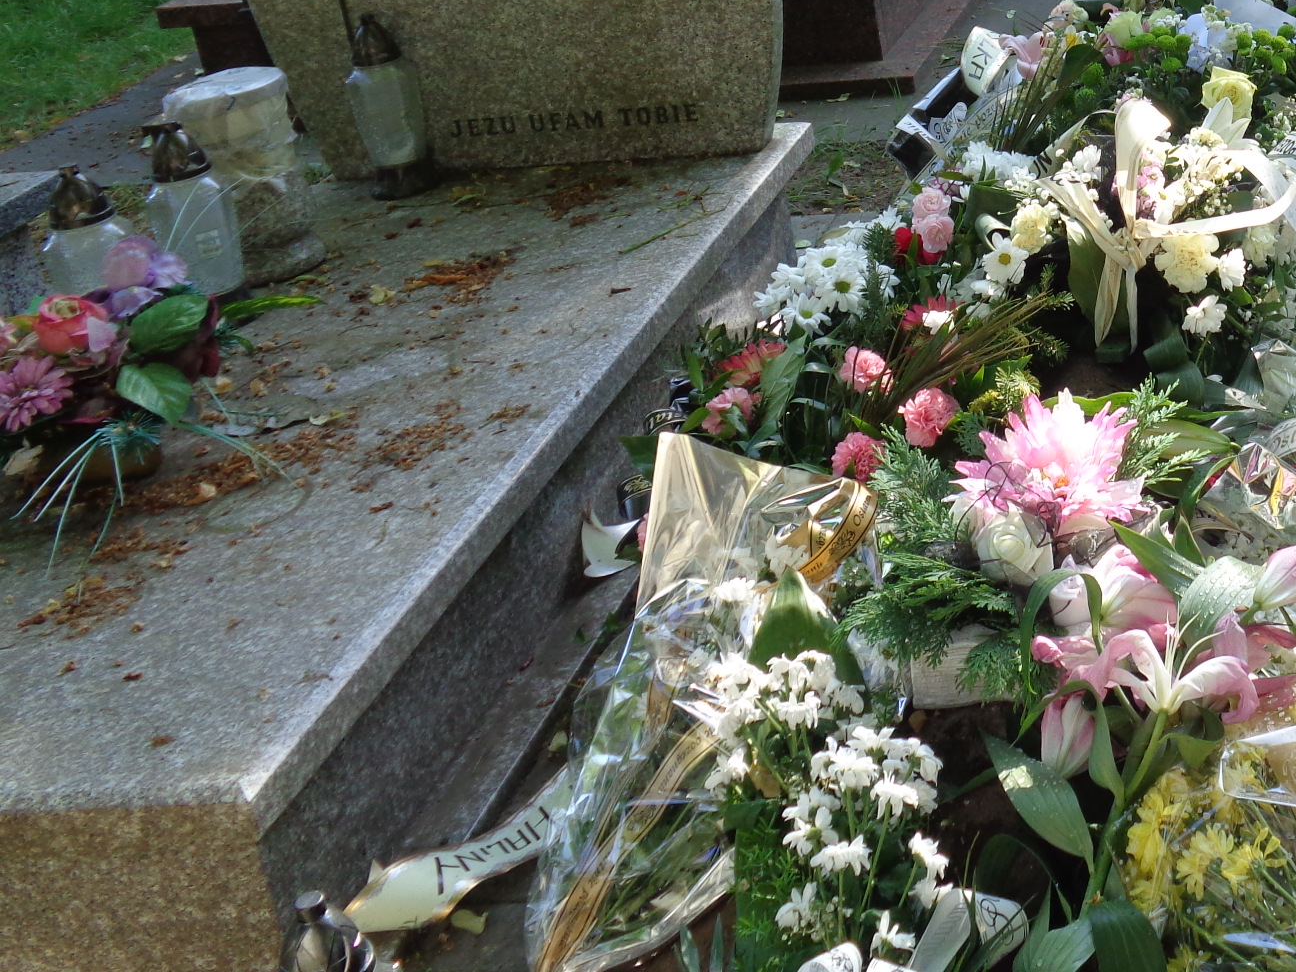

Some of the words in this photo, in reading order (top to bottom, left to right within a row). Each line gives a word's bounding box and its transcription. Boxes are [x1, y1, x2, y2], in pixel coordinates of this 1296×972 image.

[450, 114, 517, 139] JEZU
[529, 108, 604, 133] UFAM
[617, 102, 701, 126] TOBIE
